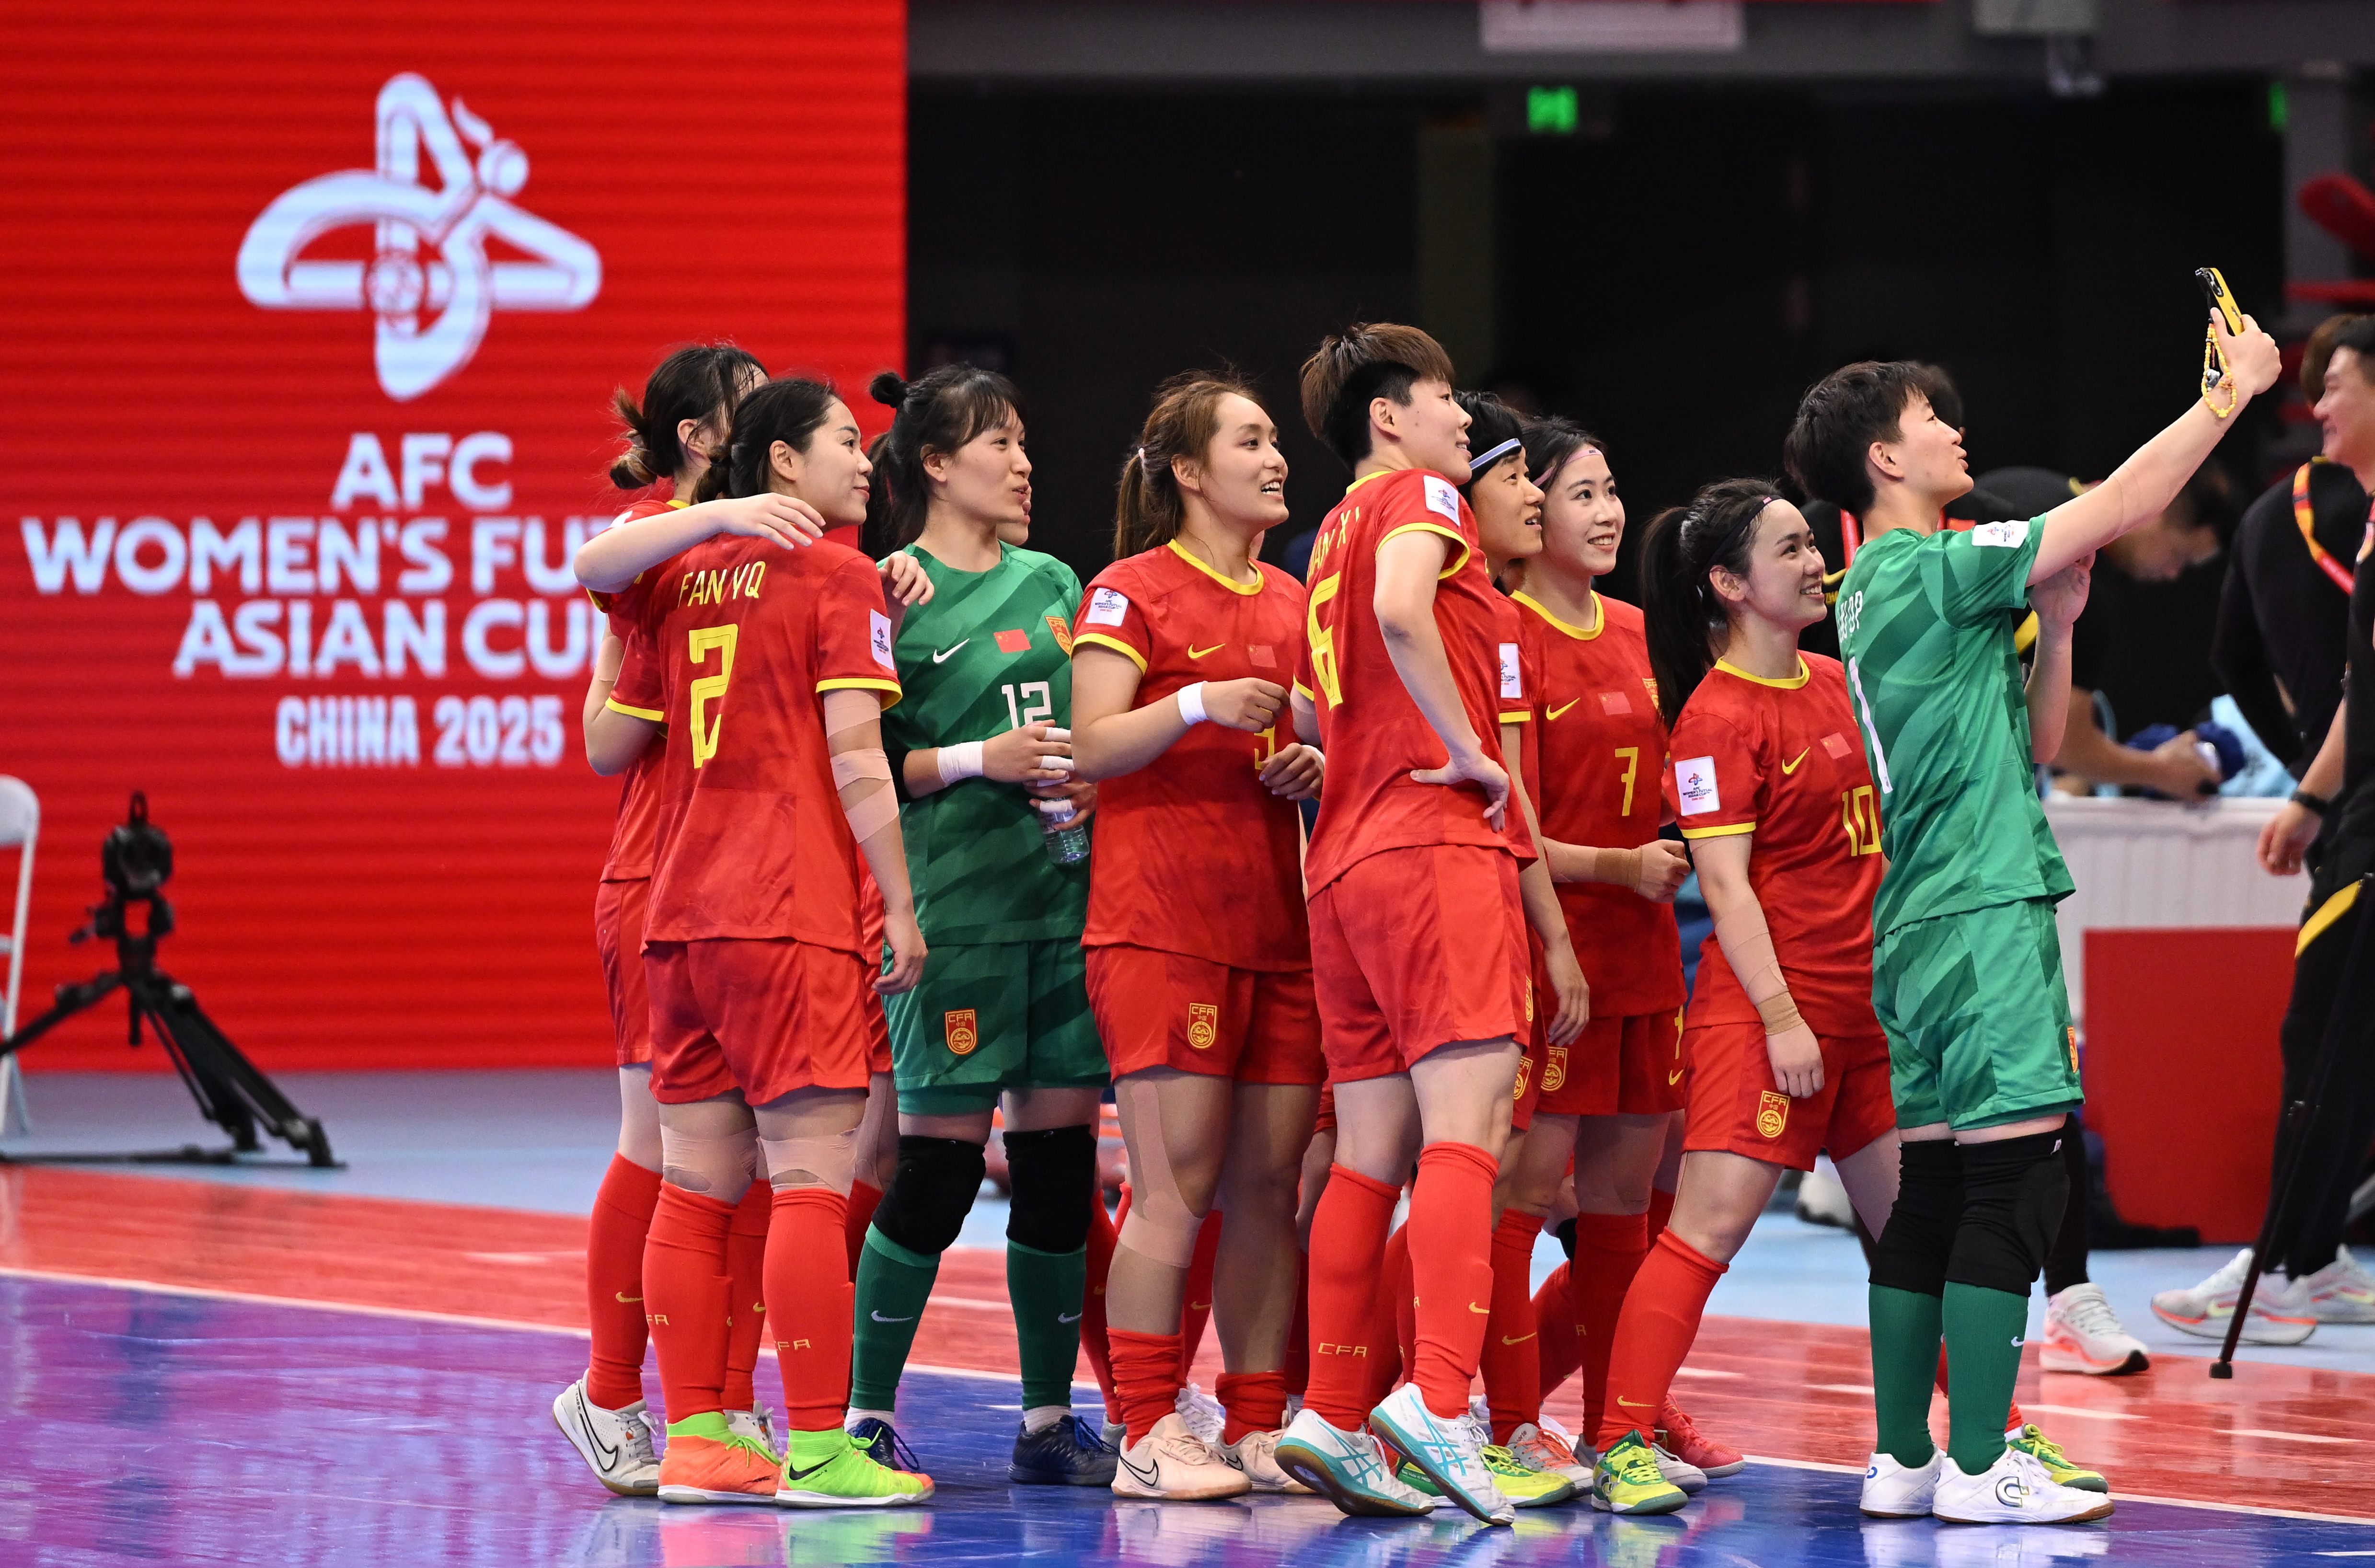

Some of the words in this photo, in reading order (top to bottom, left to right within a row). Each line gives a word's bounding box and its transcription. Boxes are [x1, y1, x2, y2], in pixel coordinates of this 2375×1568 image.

[331, 431, 514, 511] AFC
[21, 517, 452, 594] WOMEN'S
[471, 517, 617, 595] FU
[678, 569, 727, 608] FAN
[733, 561, 766, 600] YQ
[173, 600, 447, 677] ASIAN
[1308, 570, 1343, 711] 6
[688, 623, 738, 769] 2
[1002, 681, 1052, 730] 12
[1849, 657, 1893, 794] 1
[276, 696, 419, 766] CHINA
[433, 696, 565, 767] 2025
[1614, 747, 1638, 817] 7
[1842, 784, 1882, 857] 10
[948, 1013, 972, 1022] CFA
[1190, 1006, 1214, 1016] CFA
[1549, 1049, 1565, 1059] FA
[1763, 1094, 1787, 1107] CFA
[646, 1314, 669, 1326] FA
[774, 1339, 811, 1351] FA
[1318, 1342, 1367, 1357] CFA
